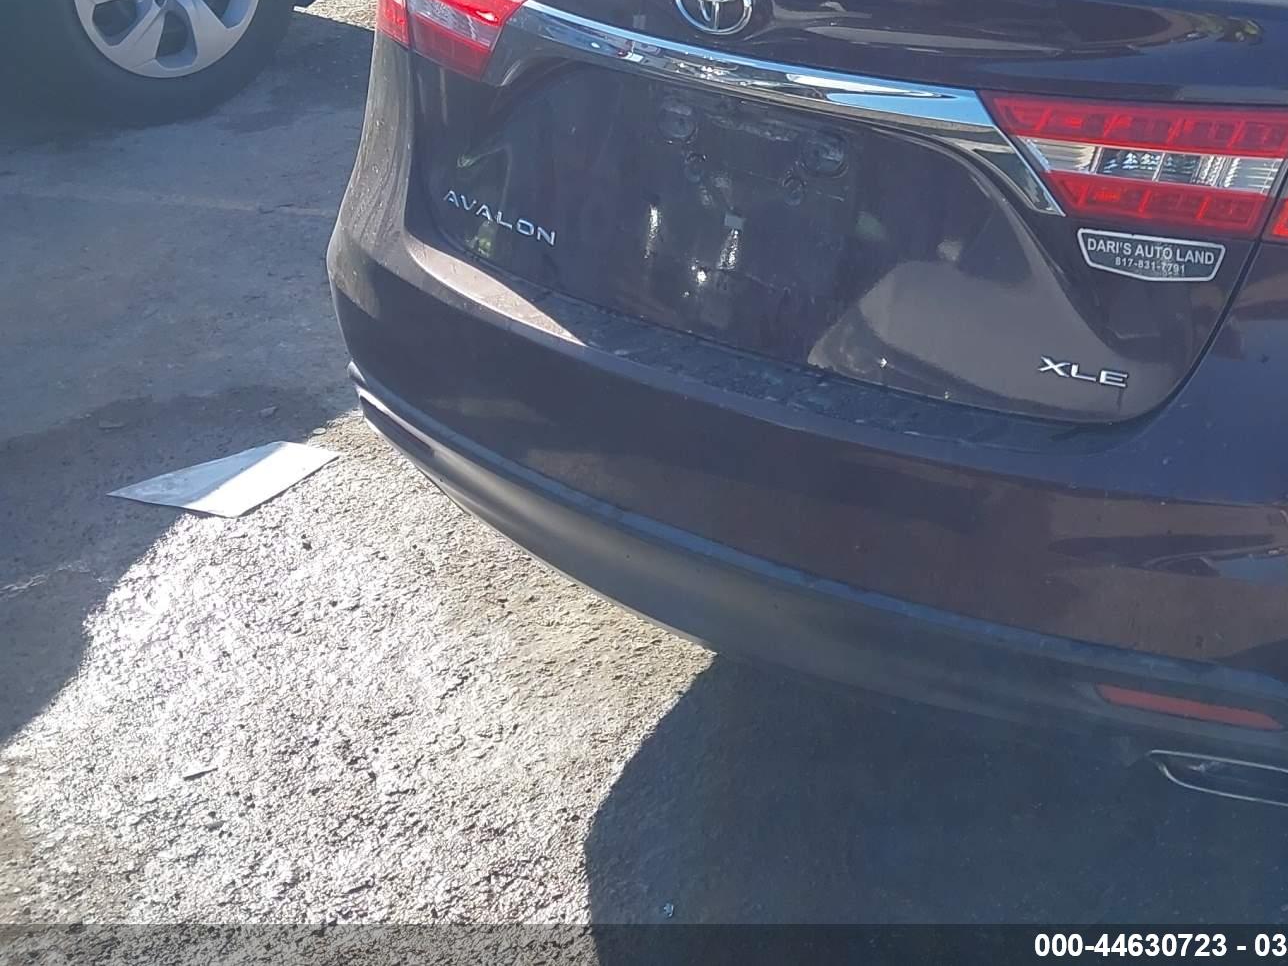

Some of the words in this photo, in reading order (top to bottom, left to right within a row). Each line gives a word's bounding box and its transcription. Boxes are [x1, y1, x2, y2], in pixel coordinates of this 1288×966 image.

[443, 190, 555, 246] AVALON
[1087, 237, 1132, 256] DARI'S
[1134, 244, 1173, 260] AUTO
[1176, 248, 1215, 265] LAND
[1037, 354, 1129, 388] XLE
